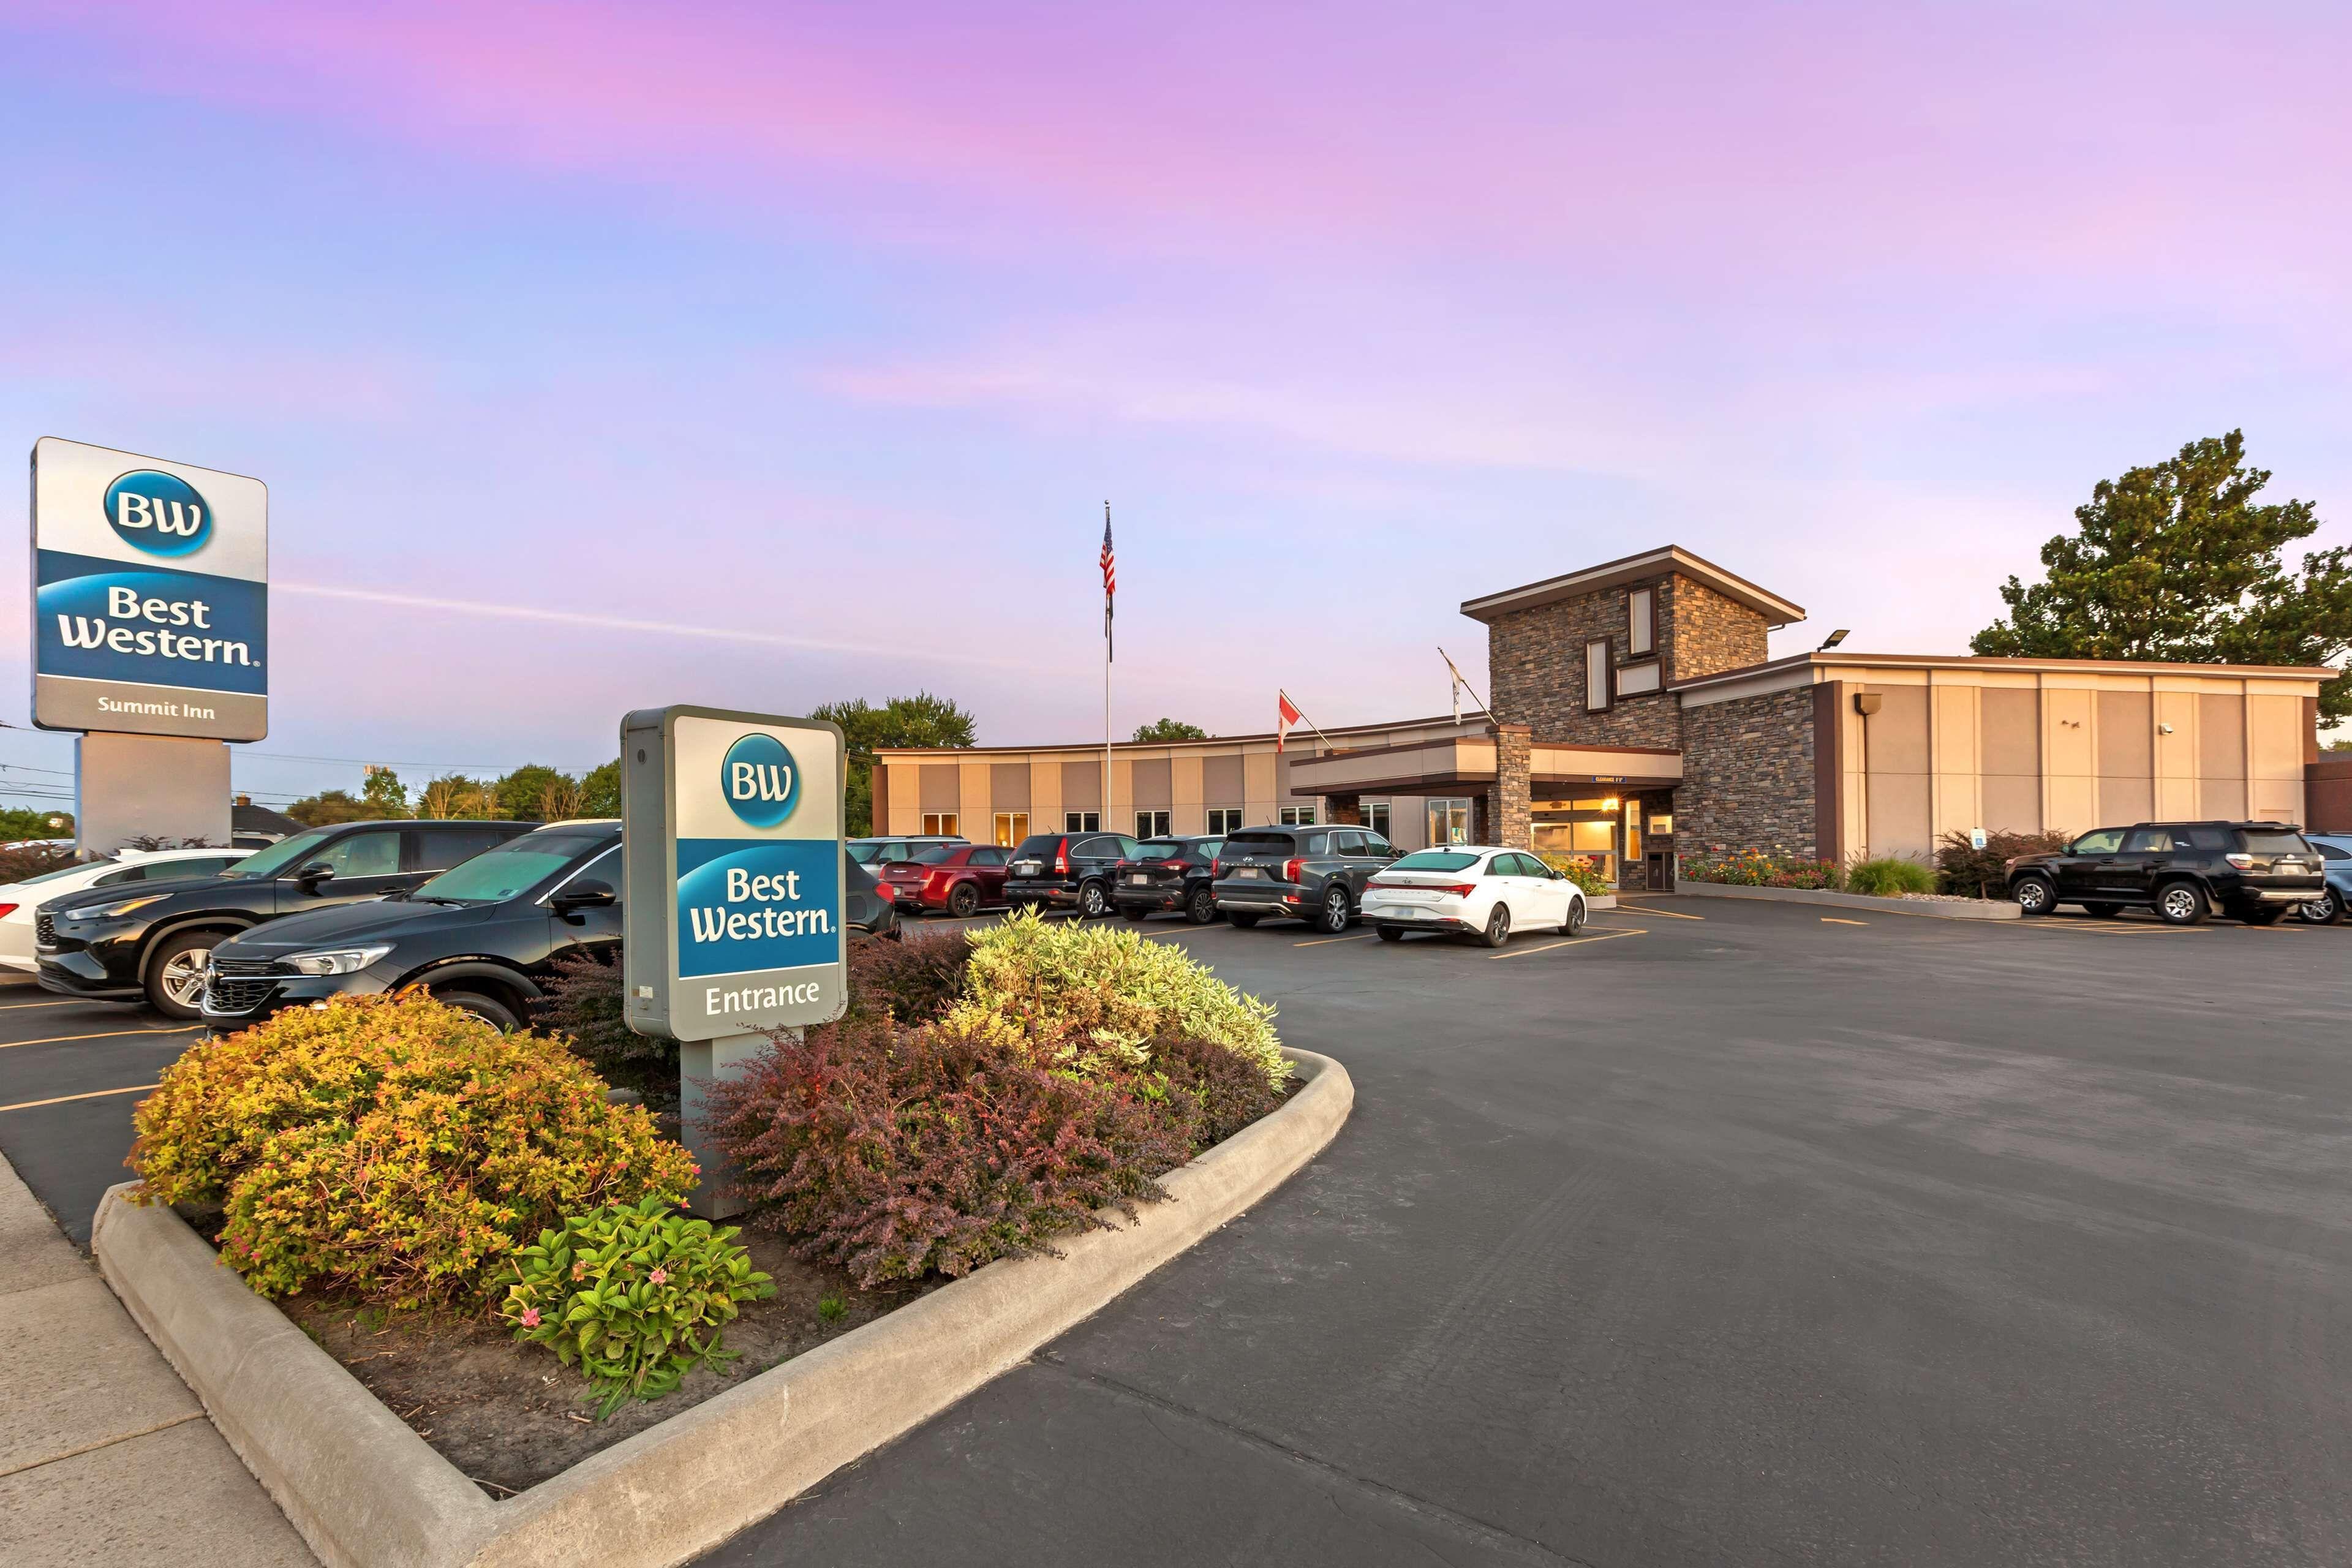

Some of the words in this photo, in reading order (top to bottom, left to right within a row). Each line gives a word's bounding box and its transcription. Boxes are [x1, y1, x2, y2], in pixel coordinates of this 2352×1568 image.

[118, 491, 202, 537] BW
[109, 586, 211, 629] Best
[58, 614, 251, 666] Western
[97, 696, 179, 717] Summit
[183, 703, 216, 720] Inn
[732, 762, 791, 801] BW
[727, 868, 801, 902] Best
[690, 907, 829, 943] Western
[706, 982, 820, 1016] Entrance
